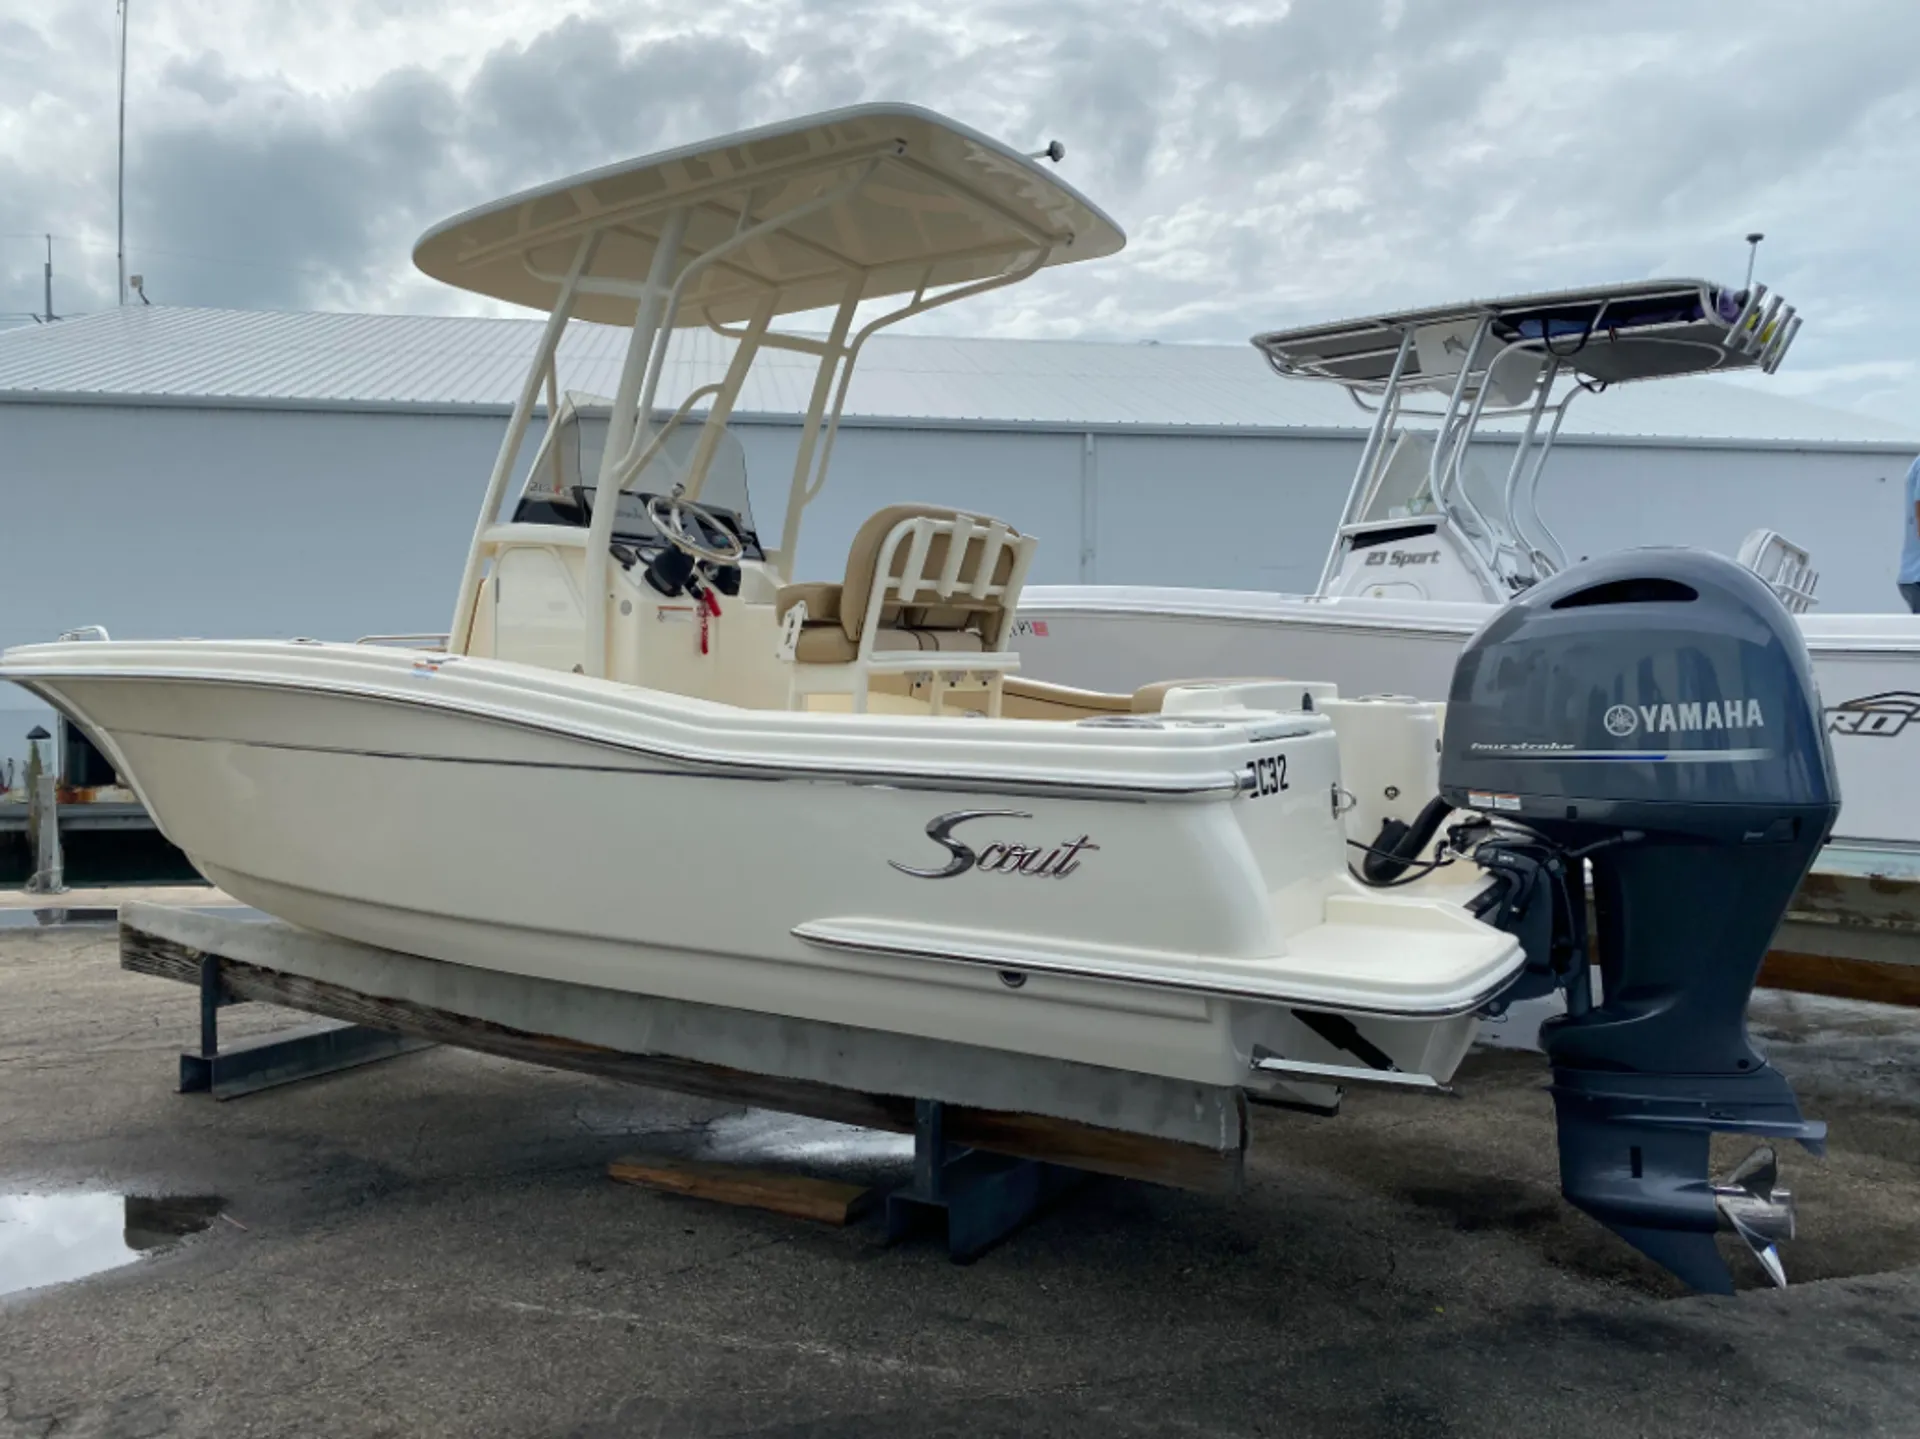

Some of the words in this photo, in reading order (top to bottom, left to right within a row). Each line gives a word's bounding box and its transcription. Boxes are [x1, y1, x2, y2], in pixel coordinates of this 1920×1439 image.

[1388, 549, 1441, 568] Sport
[1639, 699, 1765, 733] YAMAHA
[887, 809, 1100, 879] Scout
